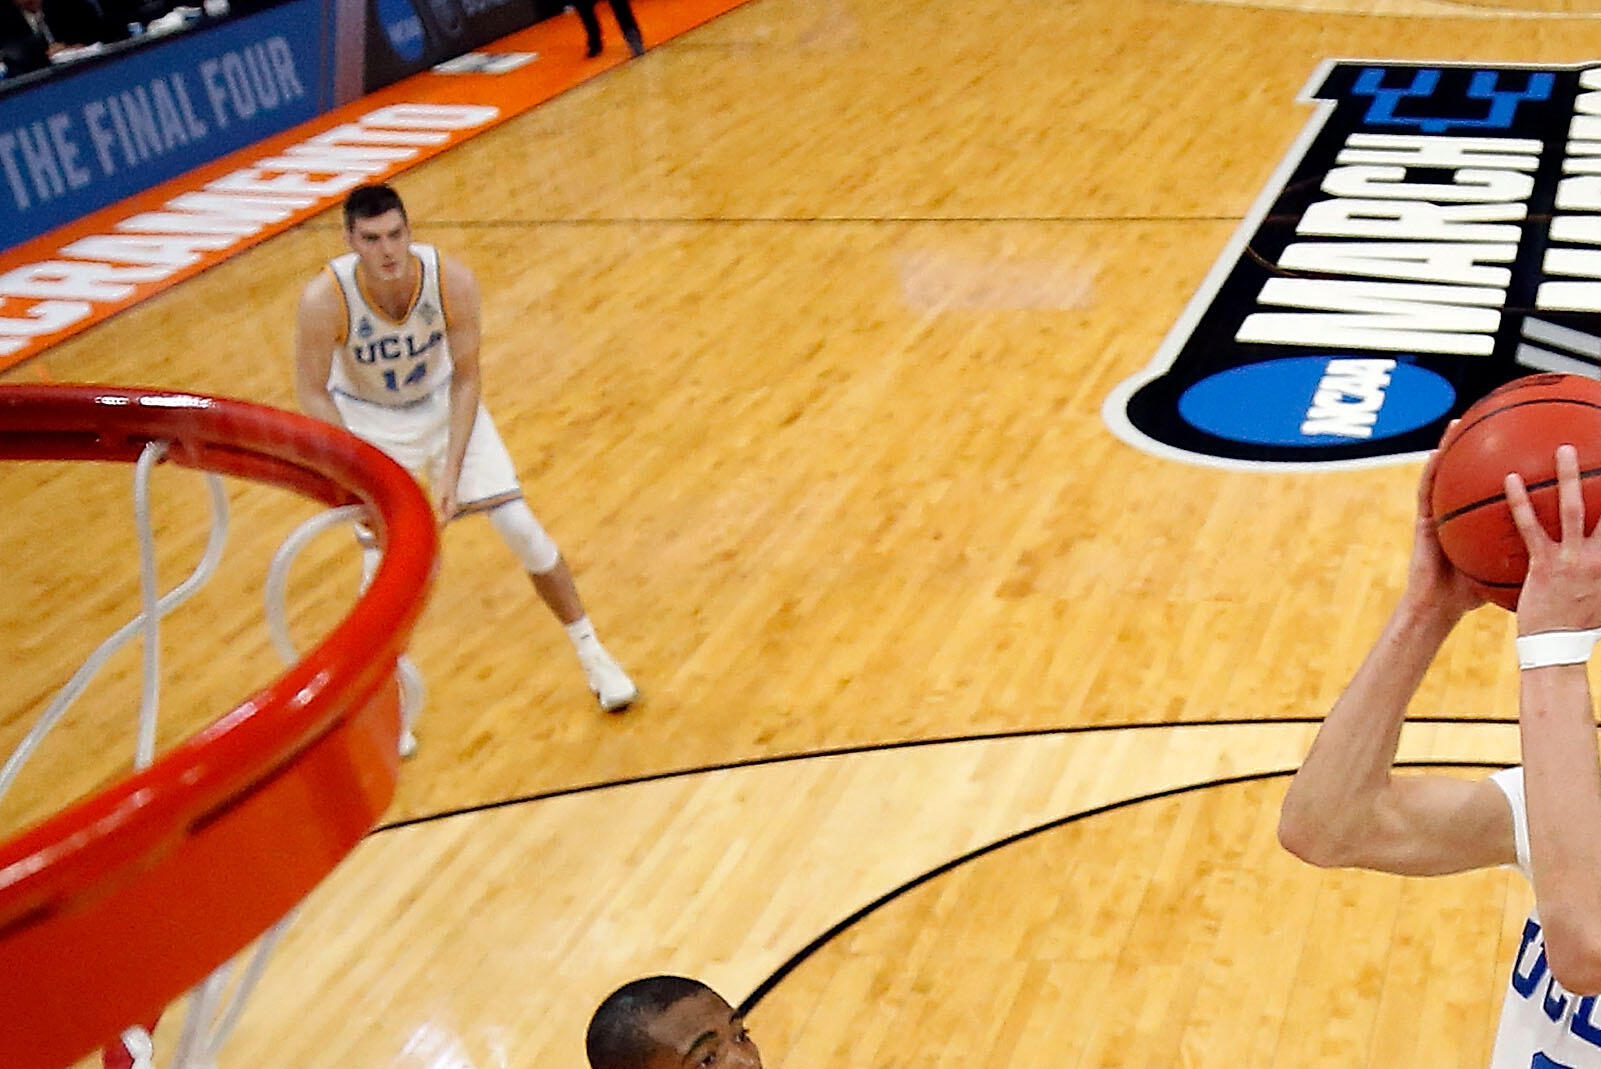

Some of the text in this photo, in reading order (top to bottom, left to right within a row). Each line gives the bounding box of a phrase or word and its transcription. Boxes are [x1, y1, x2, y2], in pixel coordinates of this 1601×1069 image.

[0, 37, 304, 211] THE FINAL FOUR
[0, 103, 500, 356] CRAMENTO
[1235, 132, 1544, 356] MARCH
[1301, 358, 1397, 439] NCAA
